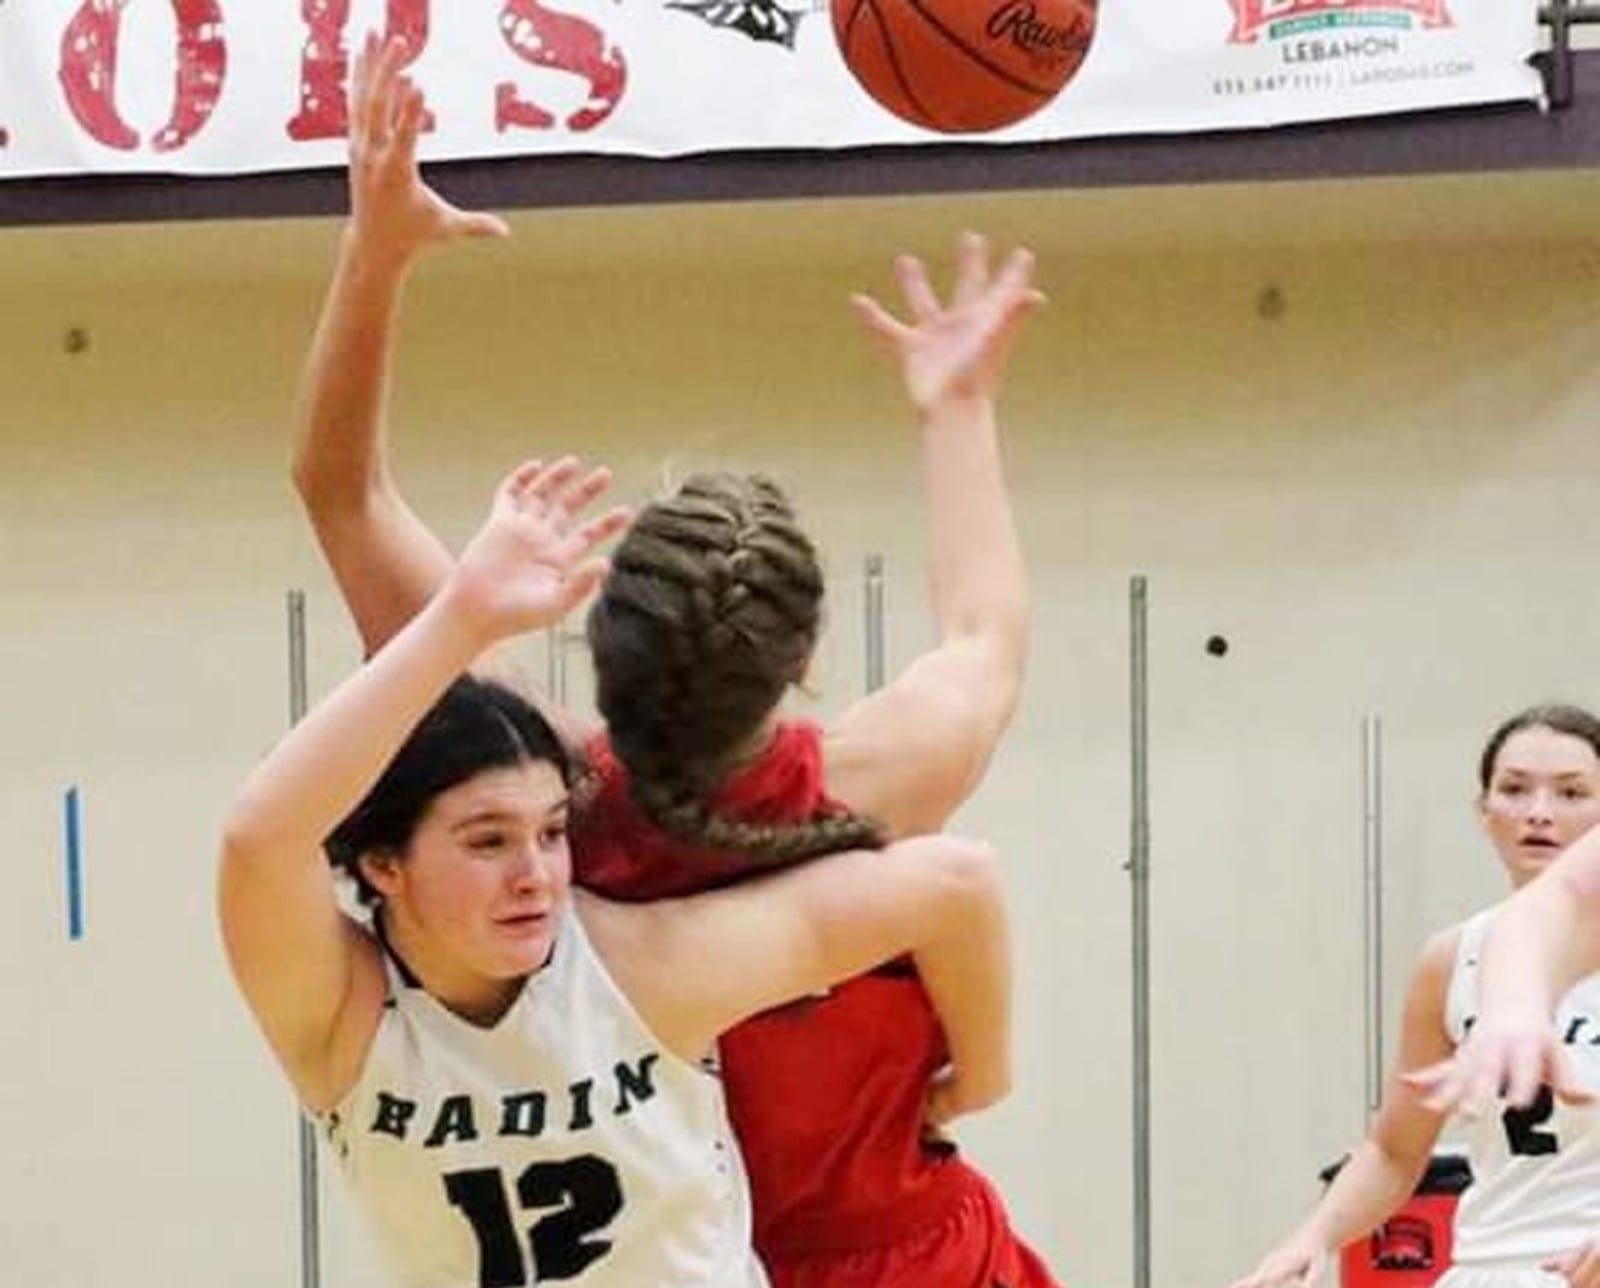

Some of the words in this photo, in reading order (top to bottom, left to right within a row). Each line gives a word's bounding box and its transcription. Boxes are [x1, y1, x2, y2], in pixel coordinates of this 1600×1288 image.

[0, 0, 627, 152] ORS
[1282, 37, 1399, 64] LEBANON
[370, 1054, 659, 1148] BADIN
